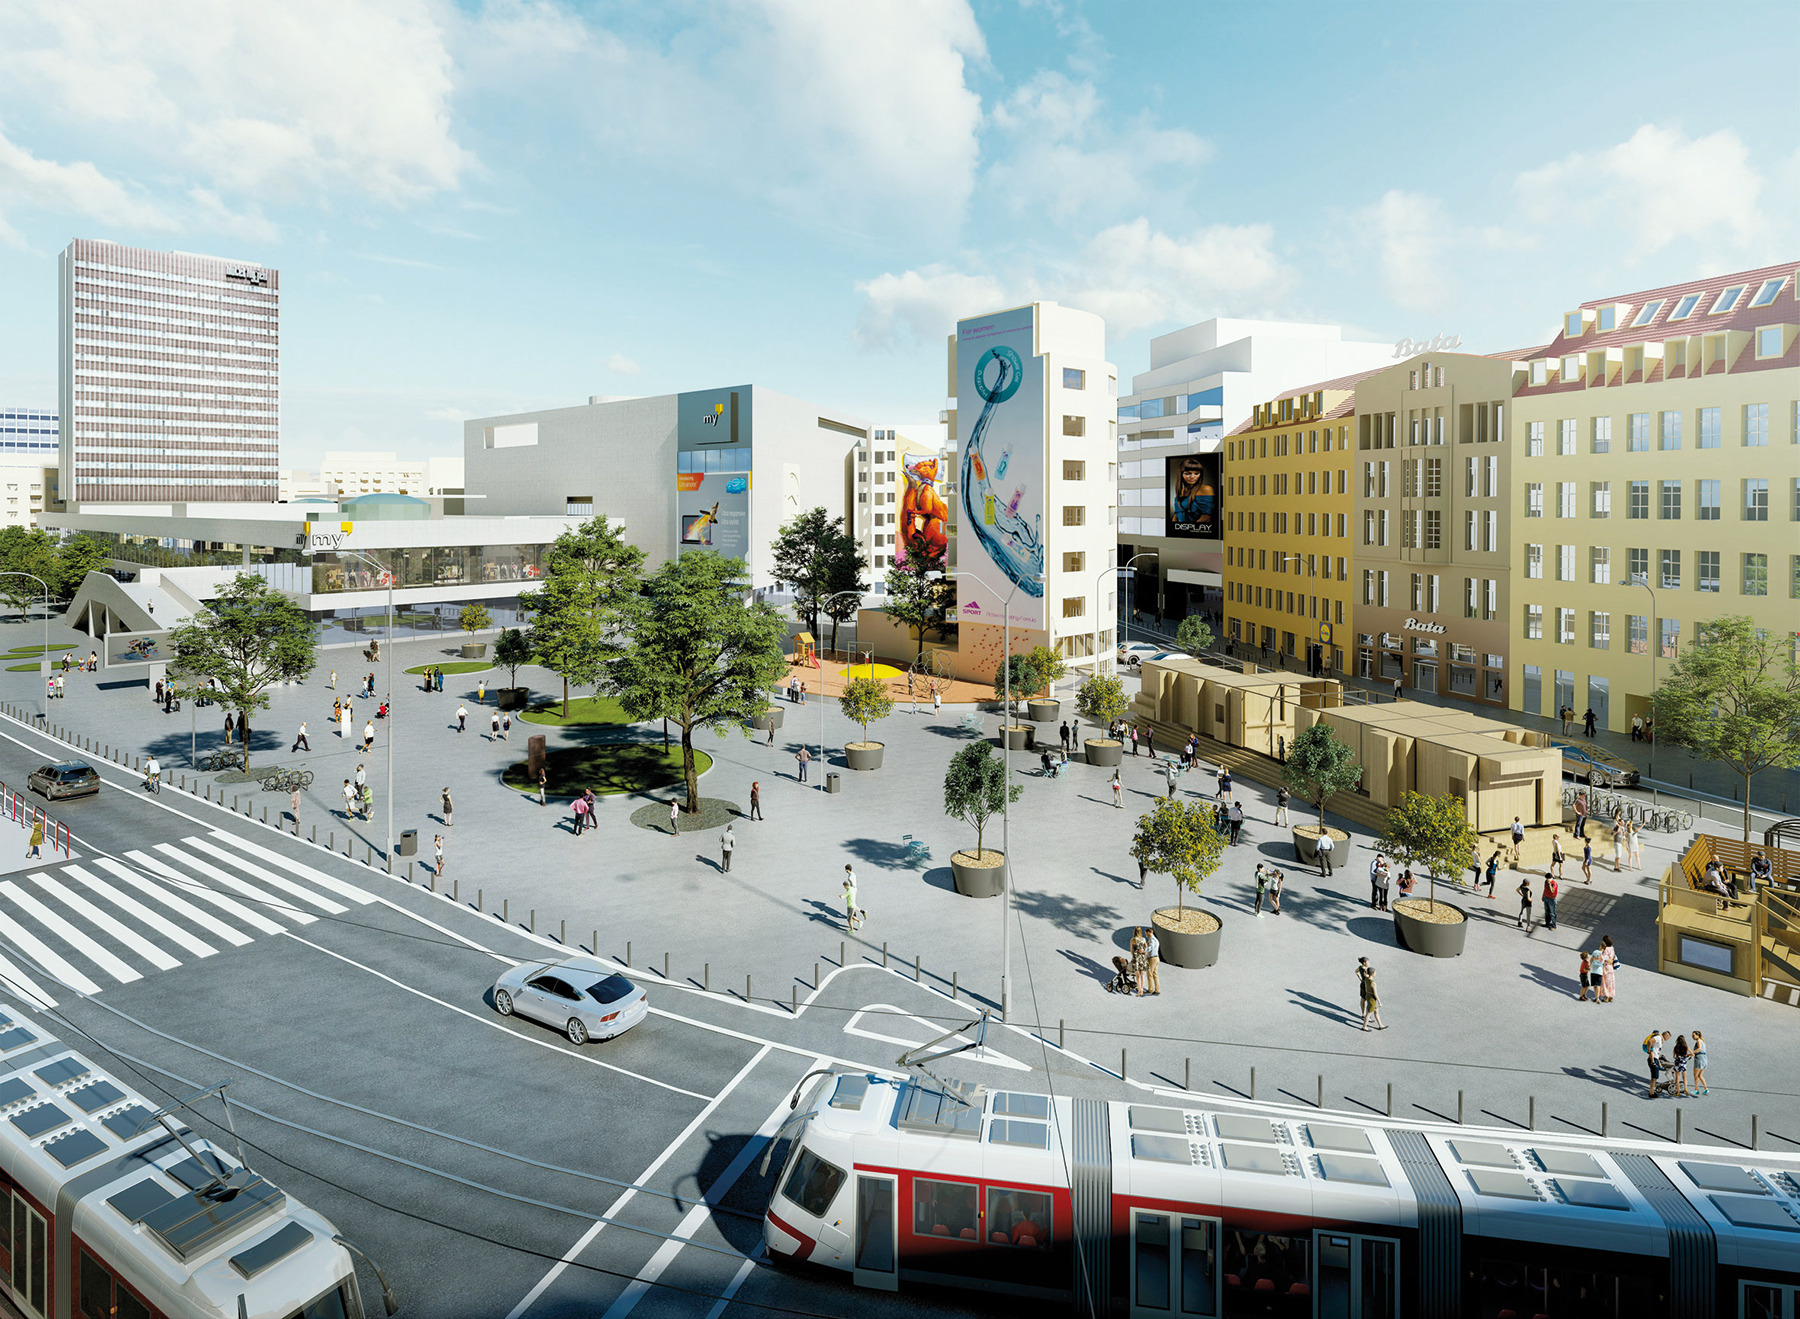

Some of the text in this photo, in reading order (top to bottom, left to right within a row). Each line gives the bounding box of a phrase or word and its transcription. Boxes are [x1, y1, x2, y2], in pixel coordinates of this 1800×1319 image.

[974, 324, 994, 334] women
[1391, 331, 1463, 358] Bata
[703, 414, 718, 426] my
[1174, 523, 1212, 531] DISPLAY
[312, 533, 344, 549] my
[1403, 617, 1447, 634] Bata
